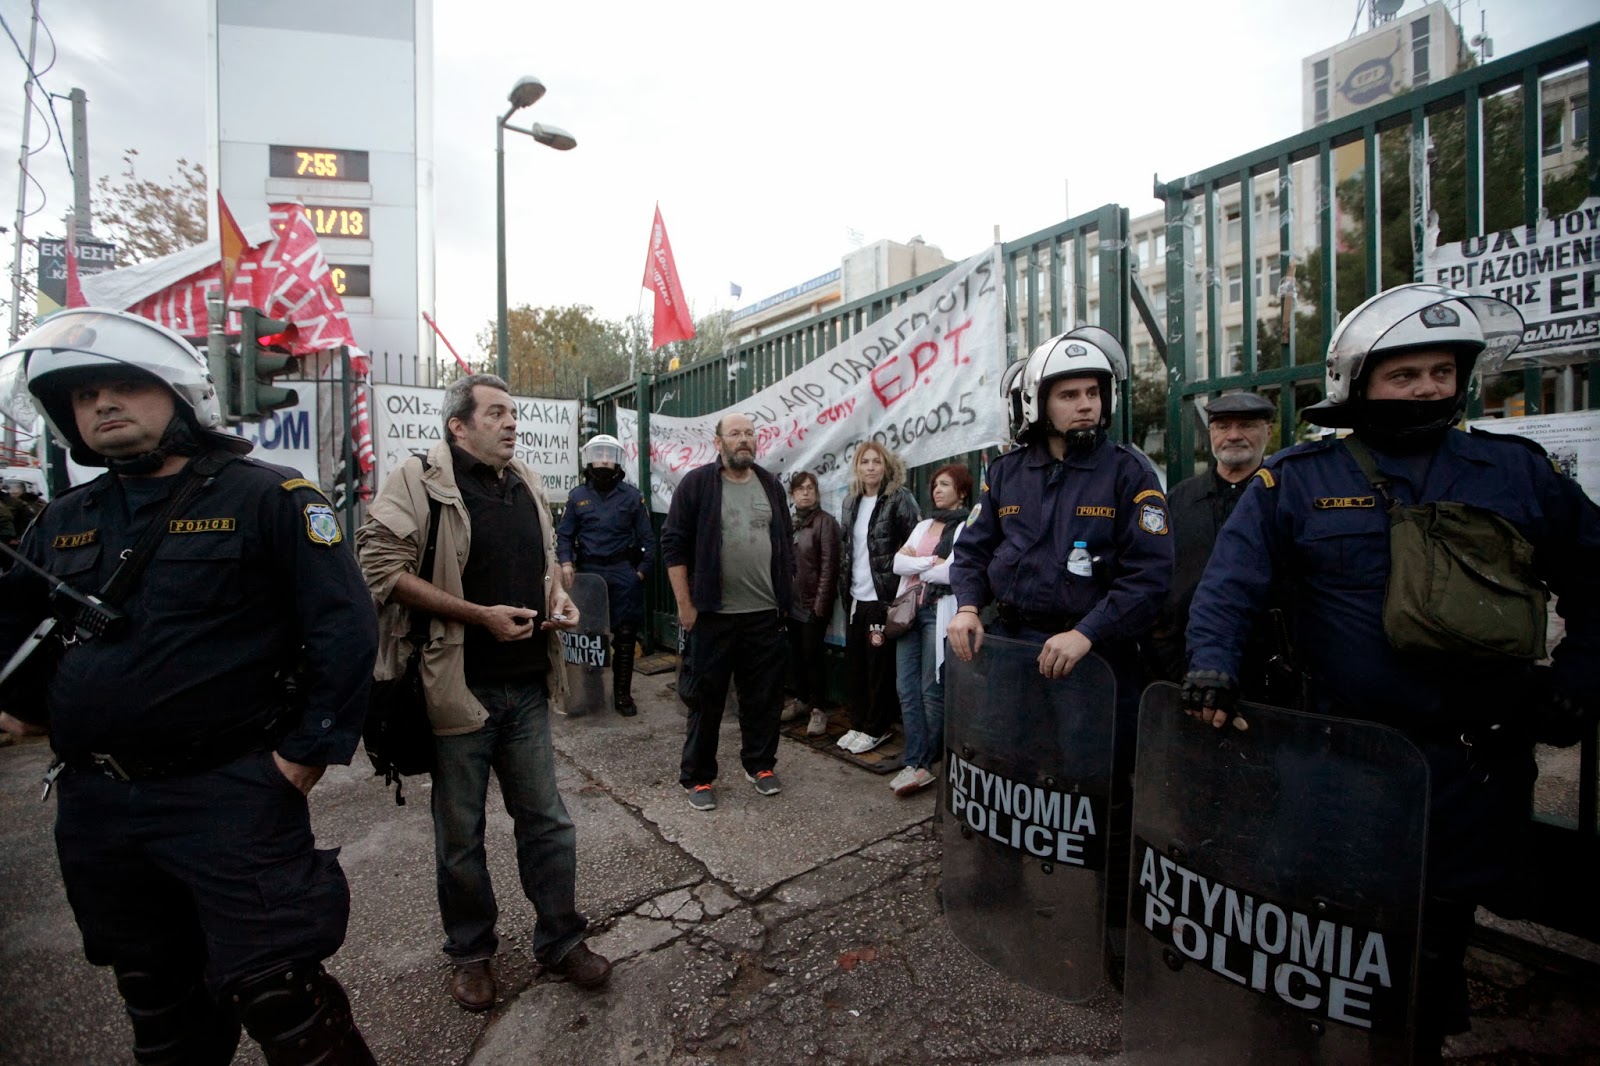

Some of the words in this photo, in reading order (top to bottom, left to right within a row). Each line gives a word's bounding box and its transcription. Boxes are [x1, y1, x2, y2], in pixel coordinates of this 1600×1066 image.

[295, 151, 338, 177] 7:55
[386, 395, 421, 416] ΟΧΙ
[778, 382, 825, 414] ΑΠΟ
[516, 401, 571, 425] ΚΑΚΙΑ
[387, 423, 442, 440] ΔΙΕΚΔ
[1080, 506, 1112, 518] POLICE
[175, 519, 230, 532] POLICE
[562, 631, 602, 650] POLIC
[949, 753, 1097, 836] ΑΣΤΥΝΟΜΙΑ
[951, 787, 1085, 867] POLICE
[1139, 846, 1393, 988] ΑΣΤΥΝΟΜΙΑ
[1145, 892, 1374, 1029] POLICE
